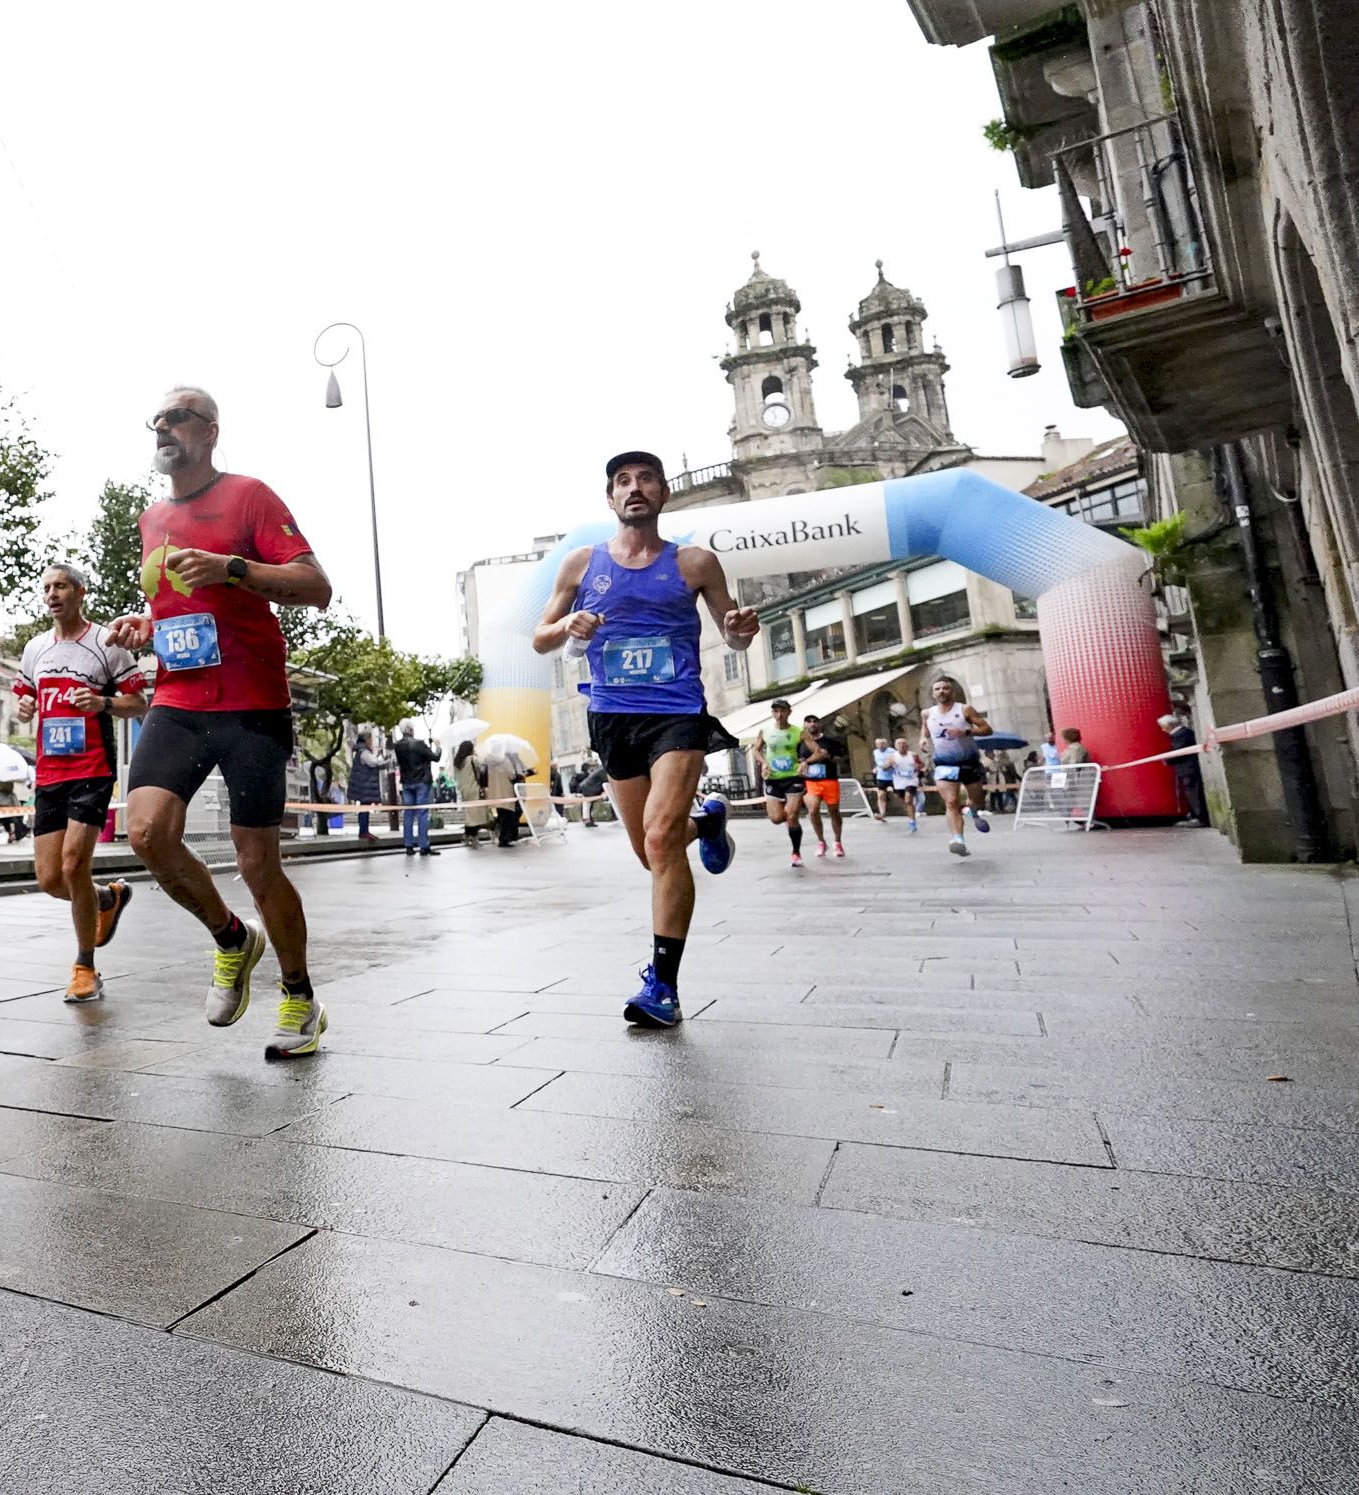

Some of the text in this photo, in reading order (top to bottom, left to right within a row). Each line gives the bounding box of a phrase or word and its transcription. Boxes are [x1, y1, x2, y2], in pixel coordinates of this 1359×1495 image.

[709, 513, 864, 553] CaixaBank
[165, 627, 200, 653] 136
[622, 648, 653, 670] 217
[41, 686, 78, 713] 17:4
[49, 726, 72, 743] 241
